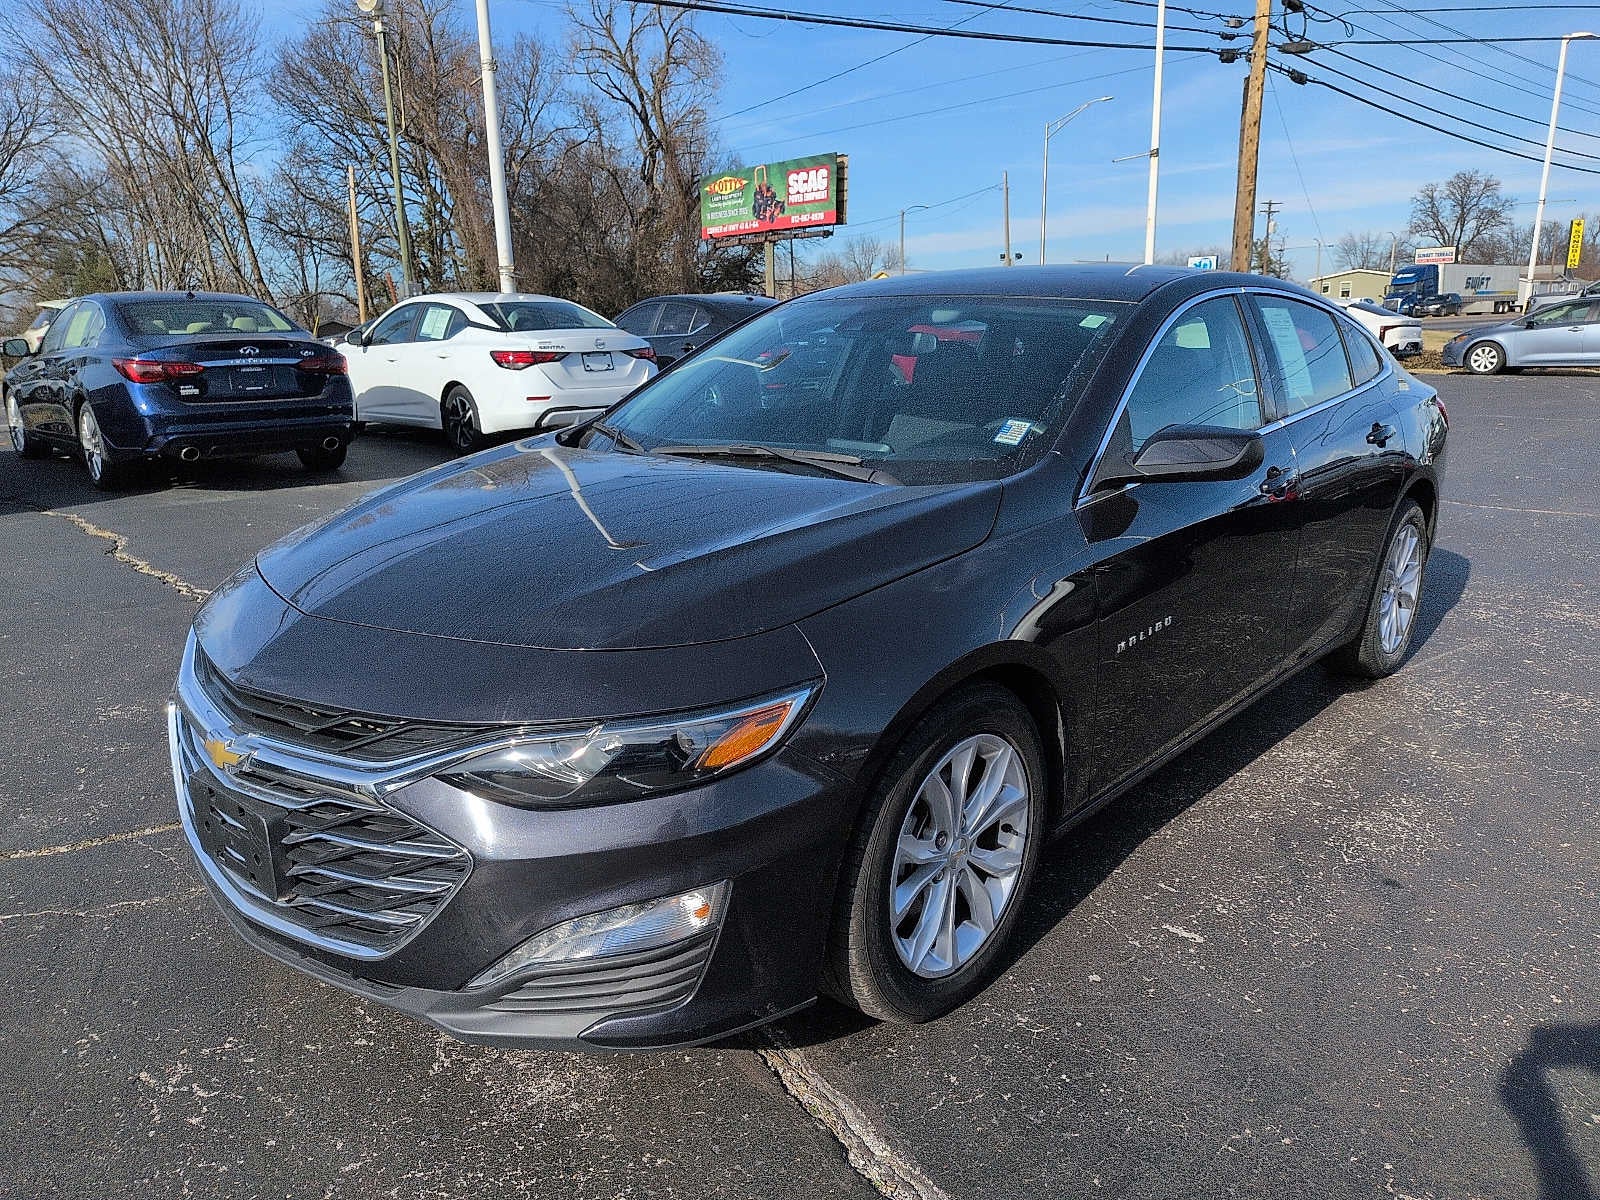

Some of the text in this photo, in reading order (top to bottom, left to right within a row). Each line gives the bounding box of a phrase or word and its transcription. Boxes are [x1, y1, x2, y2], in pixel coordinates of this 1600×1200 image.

[788, 168, 828, 195] SCAG
[804, 190, 828, 202] EQUIPMENT
[1434, 250, 1454, 258] TERRACE
[1464, 274, 1492, 290] SWIFT
[1116, 615, 1172, 654] MALIBU
